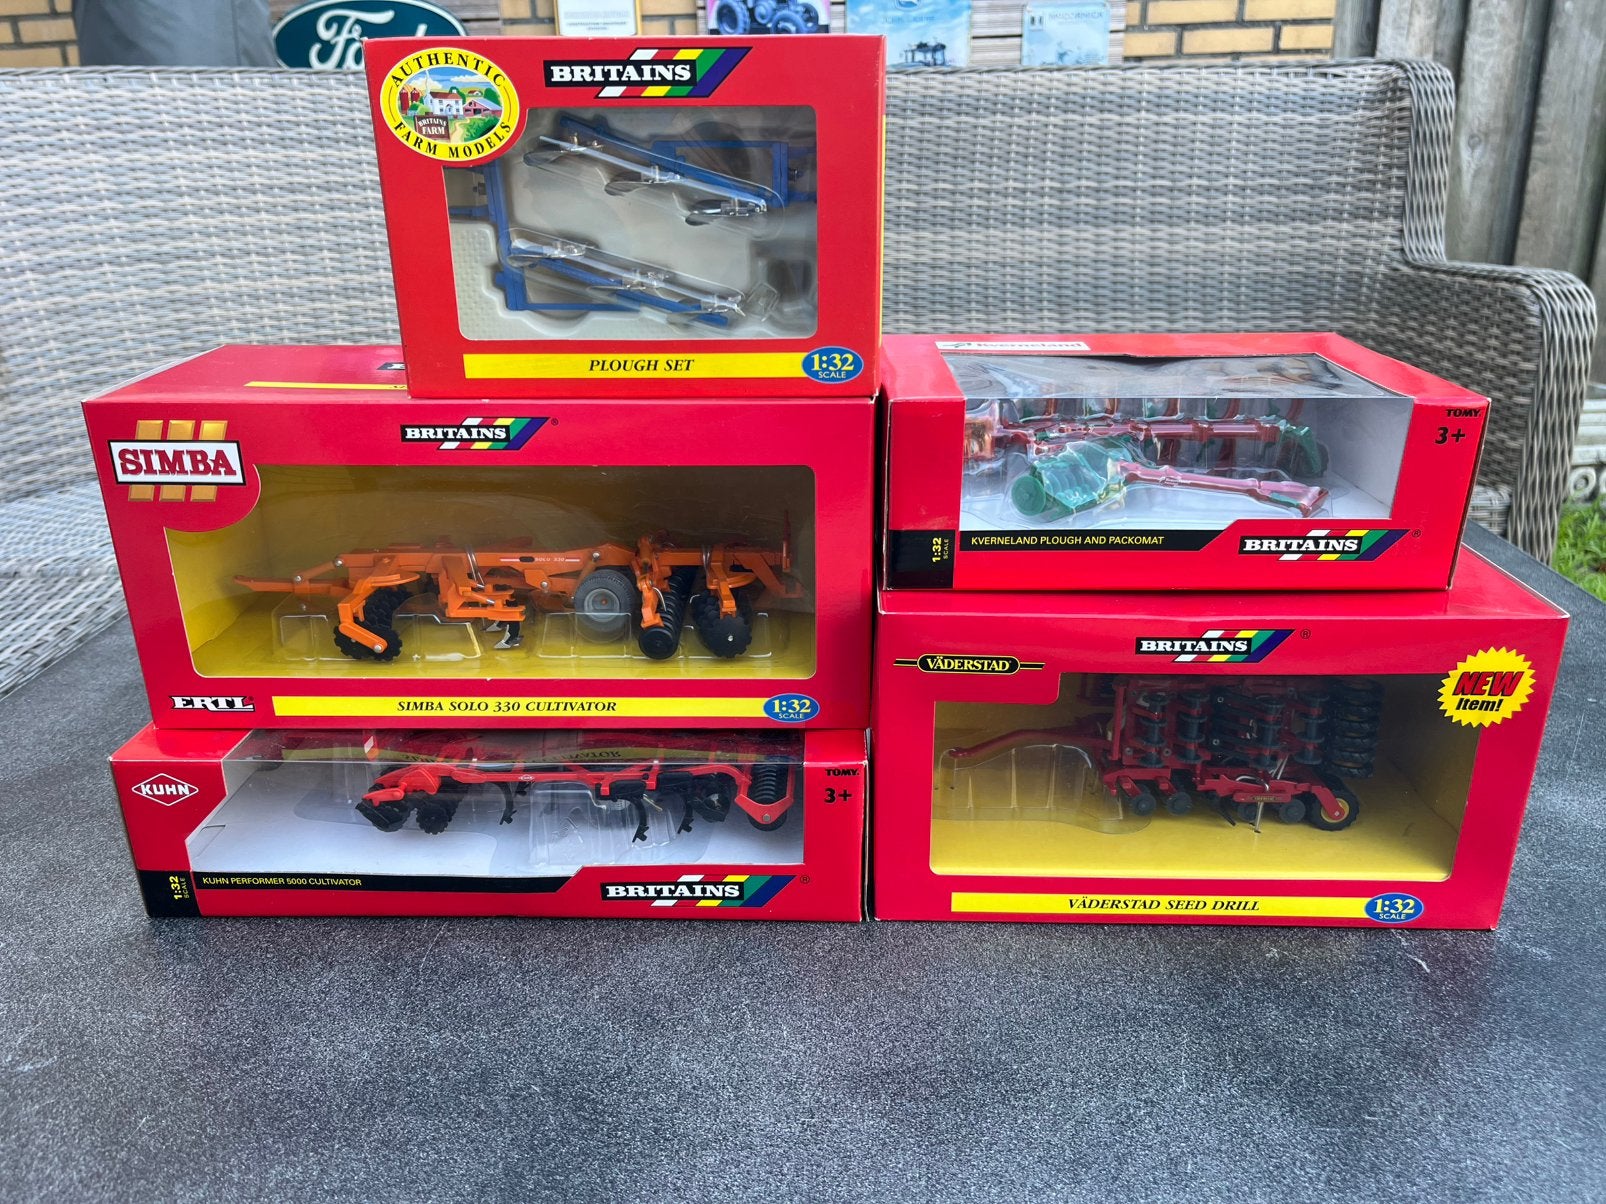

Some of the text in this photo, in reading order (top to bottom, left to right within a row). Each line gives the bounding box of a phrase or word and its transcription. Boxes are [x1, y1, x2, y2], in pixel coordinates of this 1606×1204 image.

[391, 52, 506, 88] AUTHENTIC
[550, 64, 691, 82] BRITAINS
[418, 117, 447, 127] BRITAINS
[422, 127, 446, 135] FARM
[394, 121, 511, 158] FARM MODELS
[589, 359, 695, 371] PLOUGH SET
[810, 353, 855, 371] 1:32
[1446, 408, 1480, 417] TOMY
[404, 427, 507, 439] BRITAINS
[1434, 426, 1466, 444] 3+
[118, 448, 237, 476] SIMBA
[971, 536, 1165, 545] KVERNELAND PLOUGH AND PACKOMAT
[1243, 539, 1359, 551] BRITAINS
[932, 537, 941, 562] 1:32
[1139, 640, 1248, 652] BRITAINS
[926, 656, 1010, 671] VÄDERSTAD
[1452, 671, 1525, 697] NEW
[171, 696, 254, 712] ERTL
[397, 701, 618, 713] SIMBA SOLO 330 CULTIVATOR
[772, 699, 812, 713] 1:32
[1455, 697, 1504, 712] Item!
[825, 768, 860, 776] TOMY
[140, 784, 190, 796] KUHN
[824, 787, 853, 803] 3+
[169, 875, 182, 899] 1:32
[180, 877, 189, 898] SCALE
[202, 877, 230, 885] KUHN
[231, 877, 285, 885] PERFORMER
[308, 878, 362, 886] CULTIVATOR
[606, 885, 740, 898] BRITAINS
[1068, 896, 1260, 911] VÄDERSTAD SEED DRILL
[1373, 898, 1415, 914] 1:32
